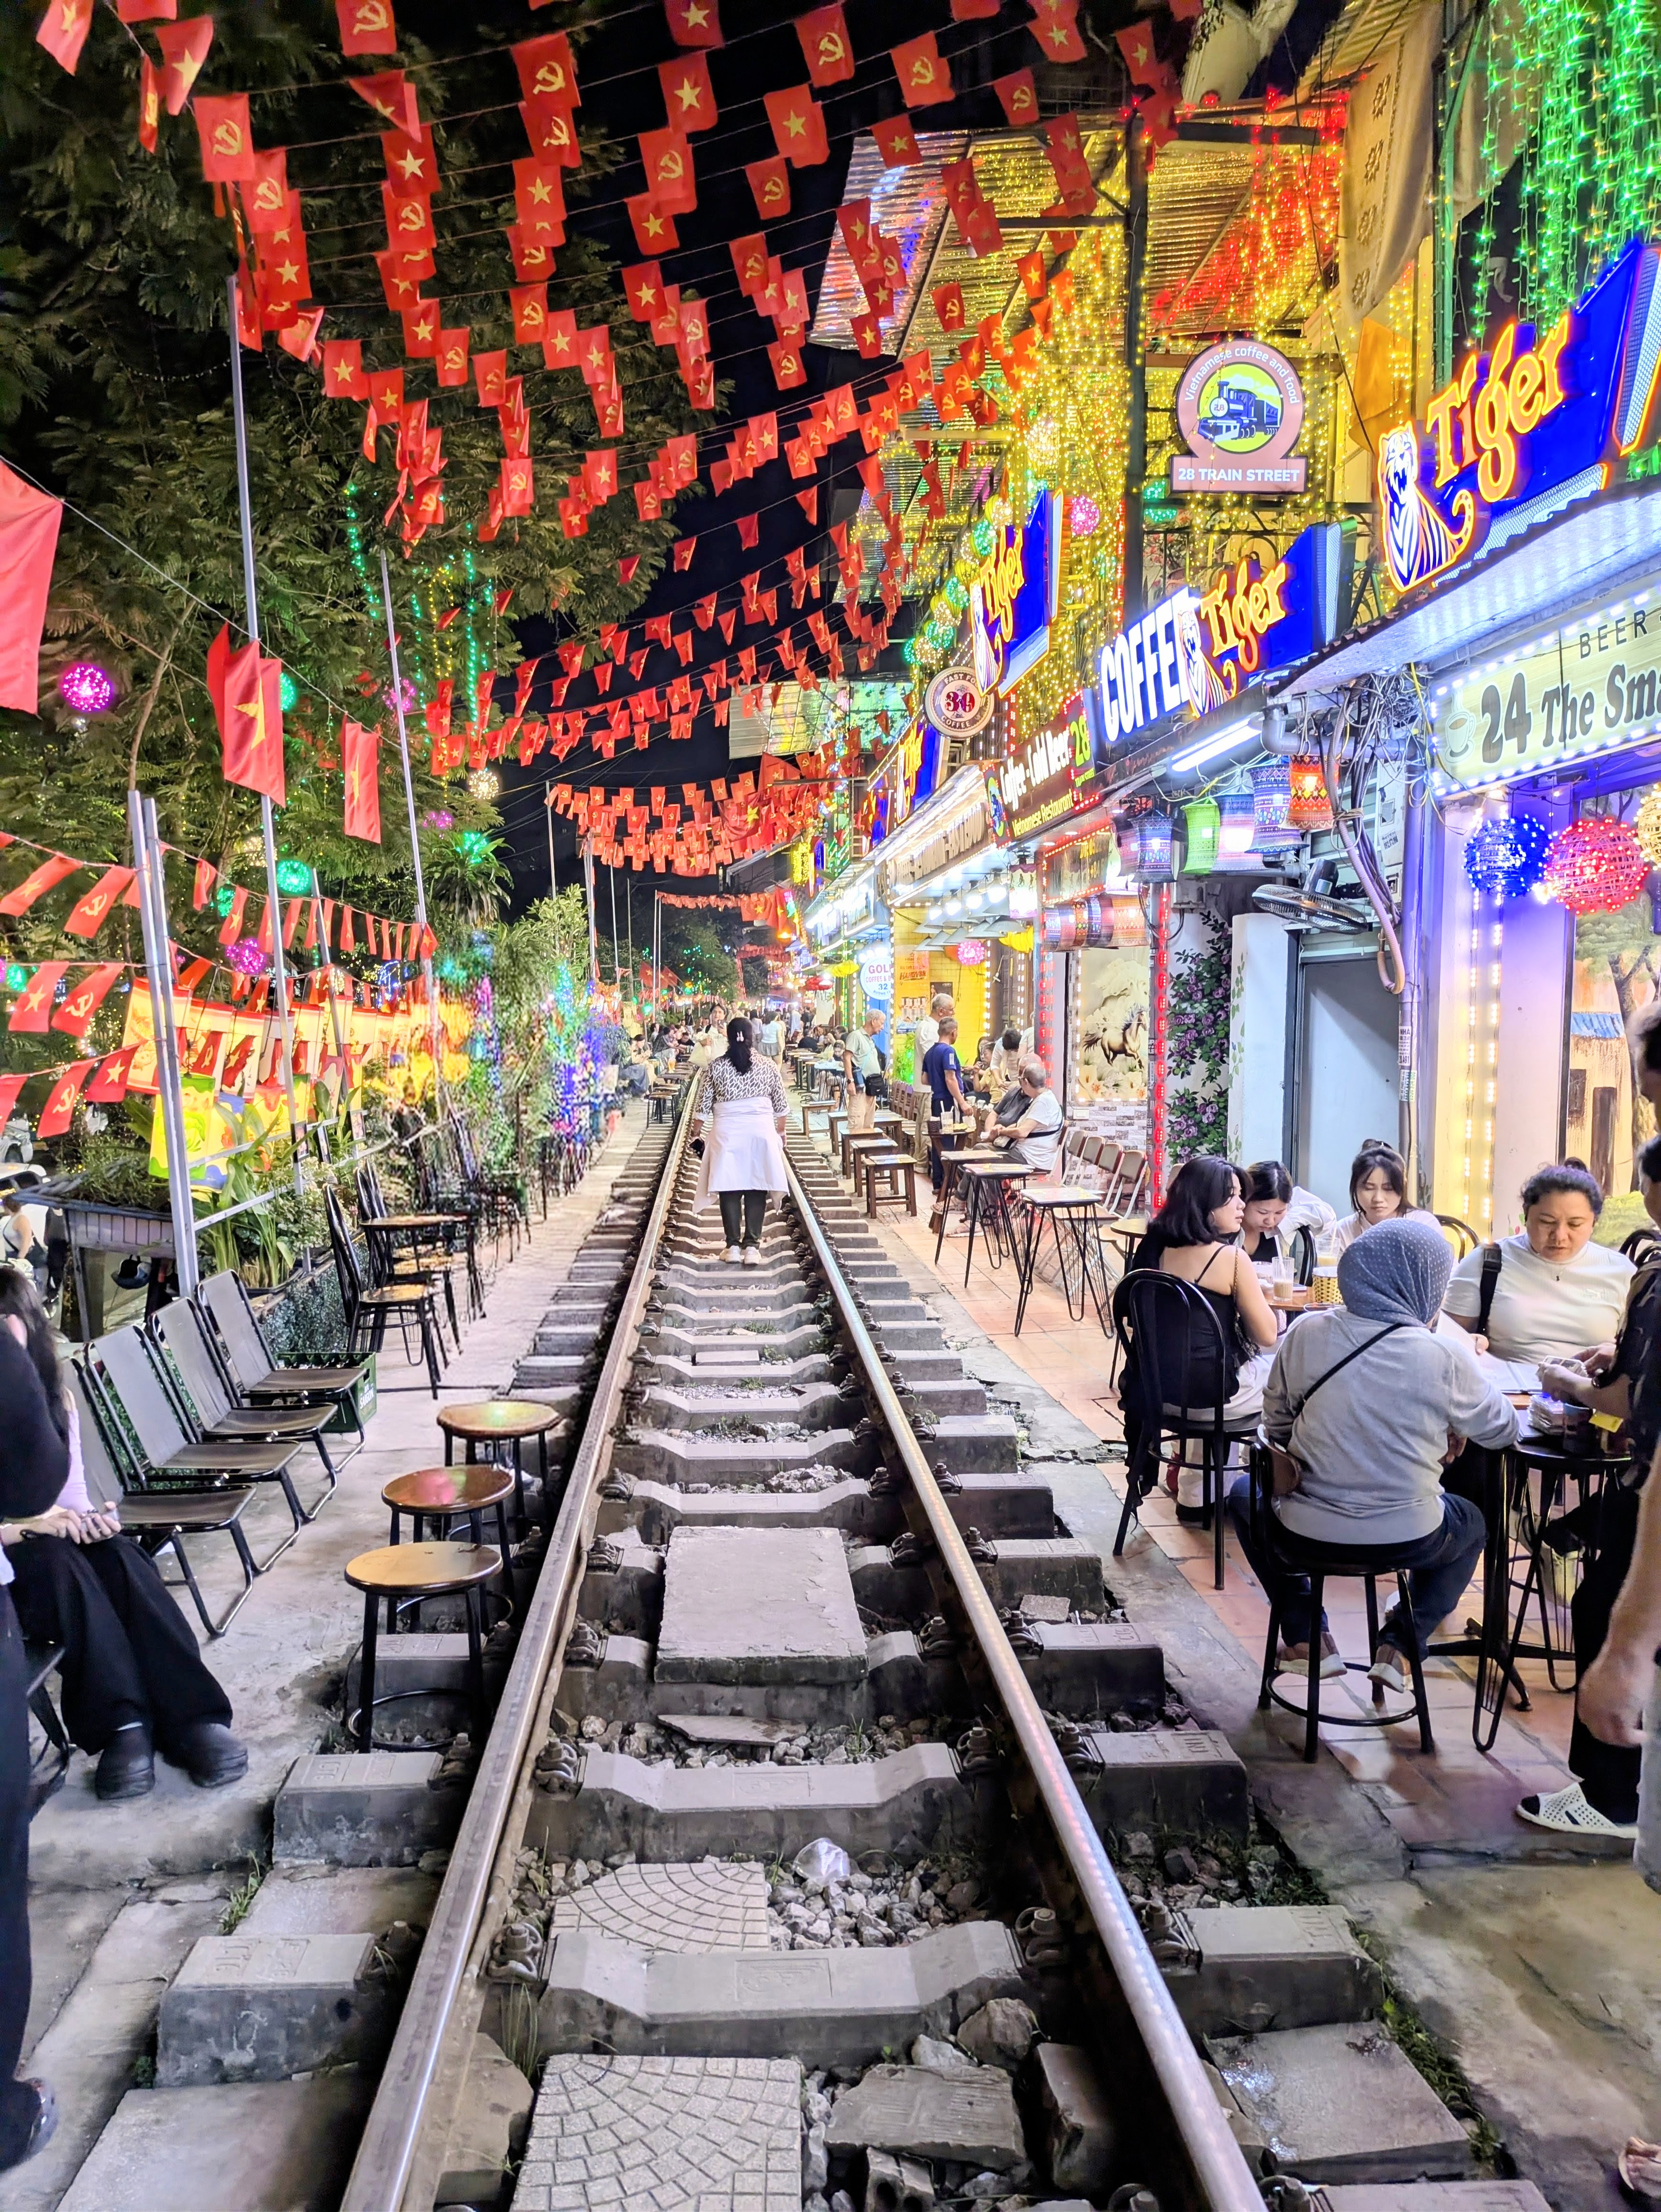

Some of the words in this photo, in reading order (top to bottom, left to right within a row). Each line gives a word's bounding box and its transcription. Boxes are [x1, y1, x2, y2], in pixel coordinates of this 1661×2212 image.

[1184, 350, 1232, 401] Vietnamese
[1235, 346, 1269, 362] coffee
[1270, 357, 1288, 377] and
[1284, 376, 1300, 404] food
[1426, 315, 1569, 503] Tiger
[1178, 468, 1195, 480] 28
[1199, 469, 1242, 481] TRAIN
[1246, 469, 1299, 482] STREET
[980, 525, 1024, 642] Tiger
[1201, 561, 1285, 672] Tiger
[1579, 609, 1648, 660] BEER
[944, 674, 963, 684] FAST
[941, 716, 971, 728] COFFEE
[1070, 715, 1091, 767] 28
[1481, 671, 1532, 764] 24
[1541, 683, 1595, 748] The
[1000, 756, 1027, 811] Coffee
[1027, 732, 1048, 787] Cold
[1045, 730, 1070, 776] Beer
[1012, 812, 1042, 837] Vietnamese
[1040, 789, 1074, 823] Restaurant
[360, 1387, 374, 1409] SAIGON
